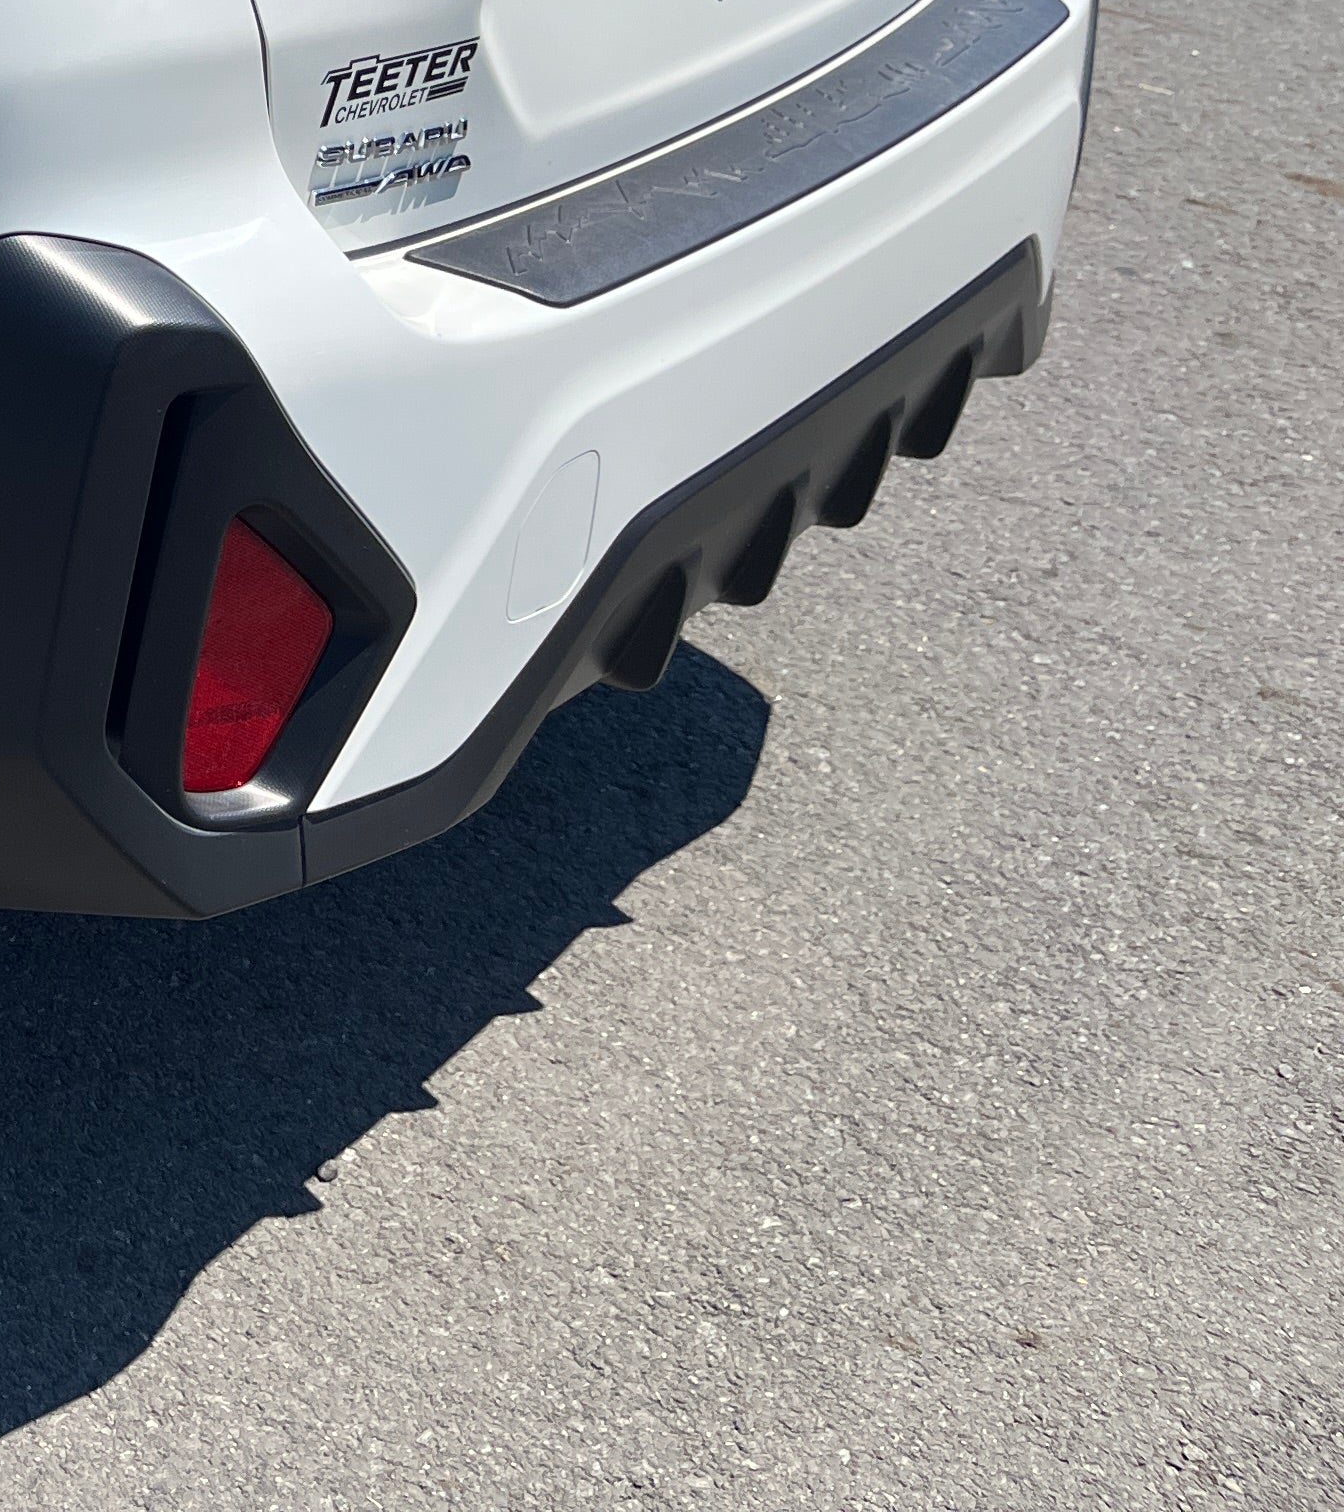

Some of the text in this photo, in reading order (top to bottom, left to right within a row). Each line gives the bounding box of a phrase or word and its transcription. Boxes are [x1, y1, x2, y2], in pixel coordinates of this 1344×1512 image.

[320, 42, 479, 128] TEETER
[335, 87, 428, 124] CHEVROLET
[316, 117, 468, 168] SUBARU
[376, 154, 472, 194] AWD
